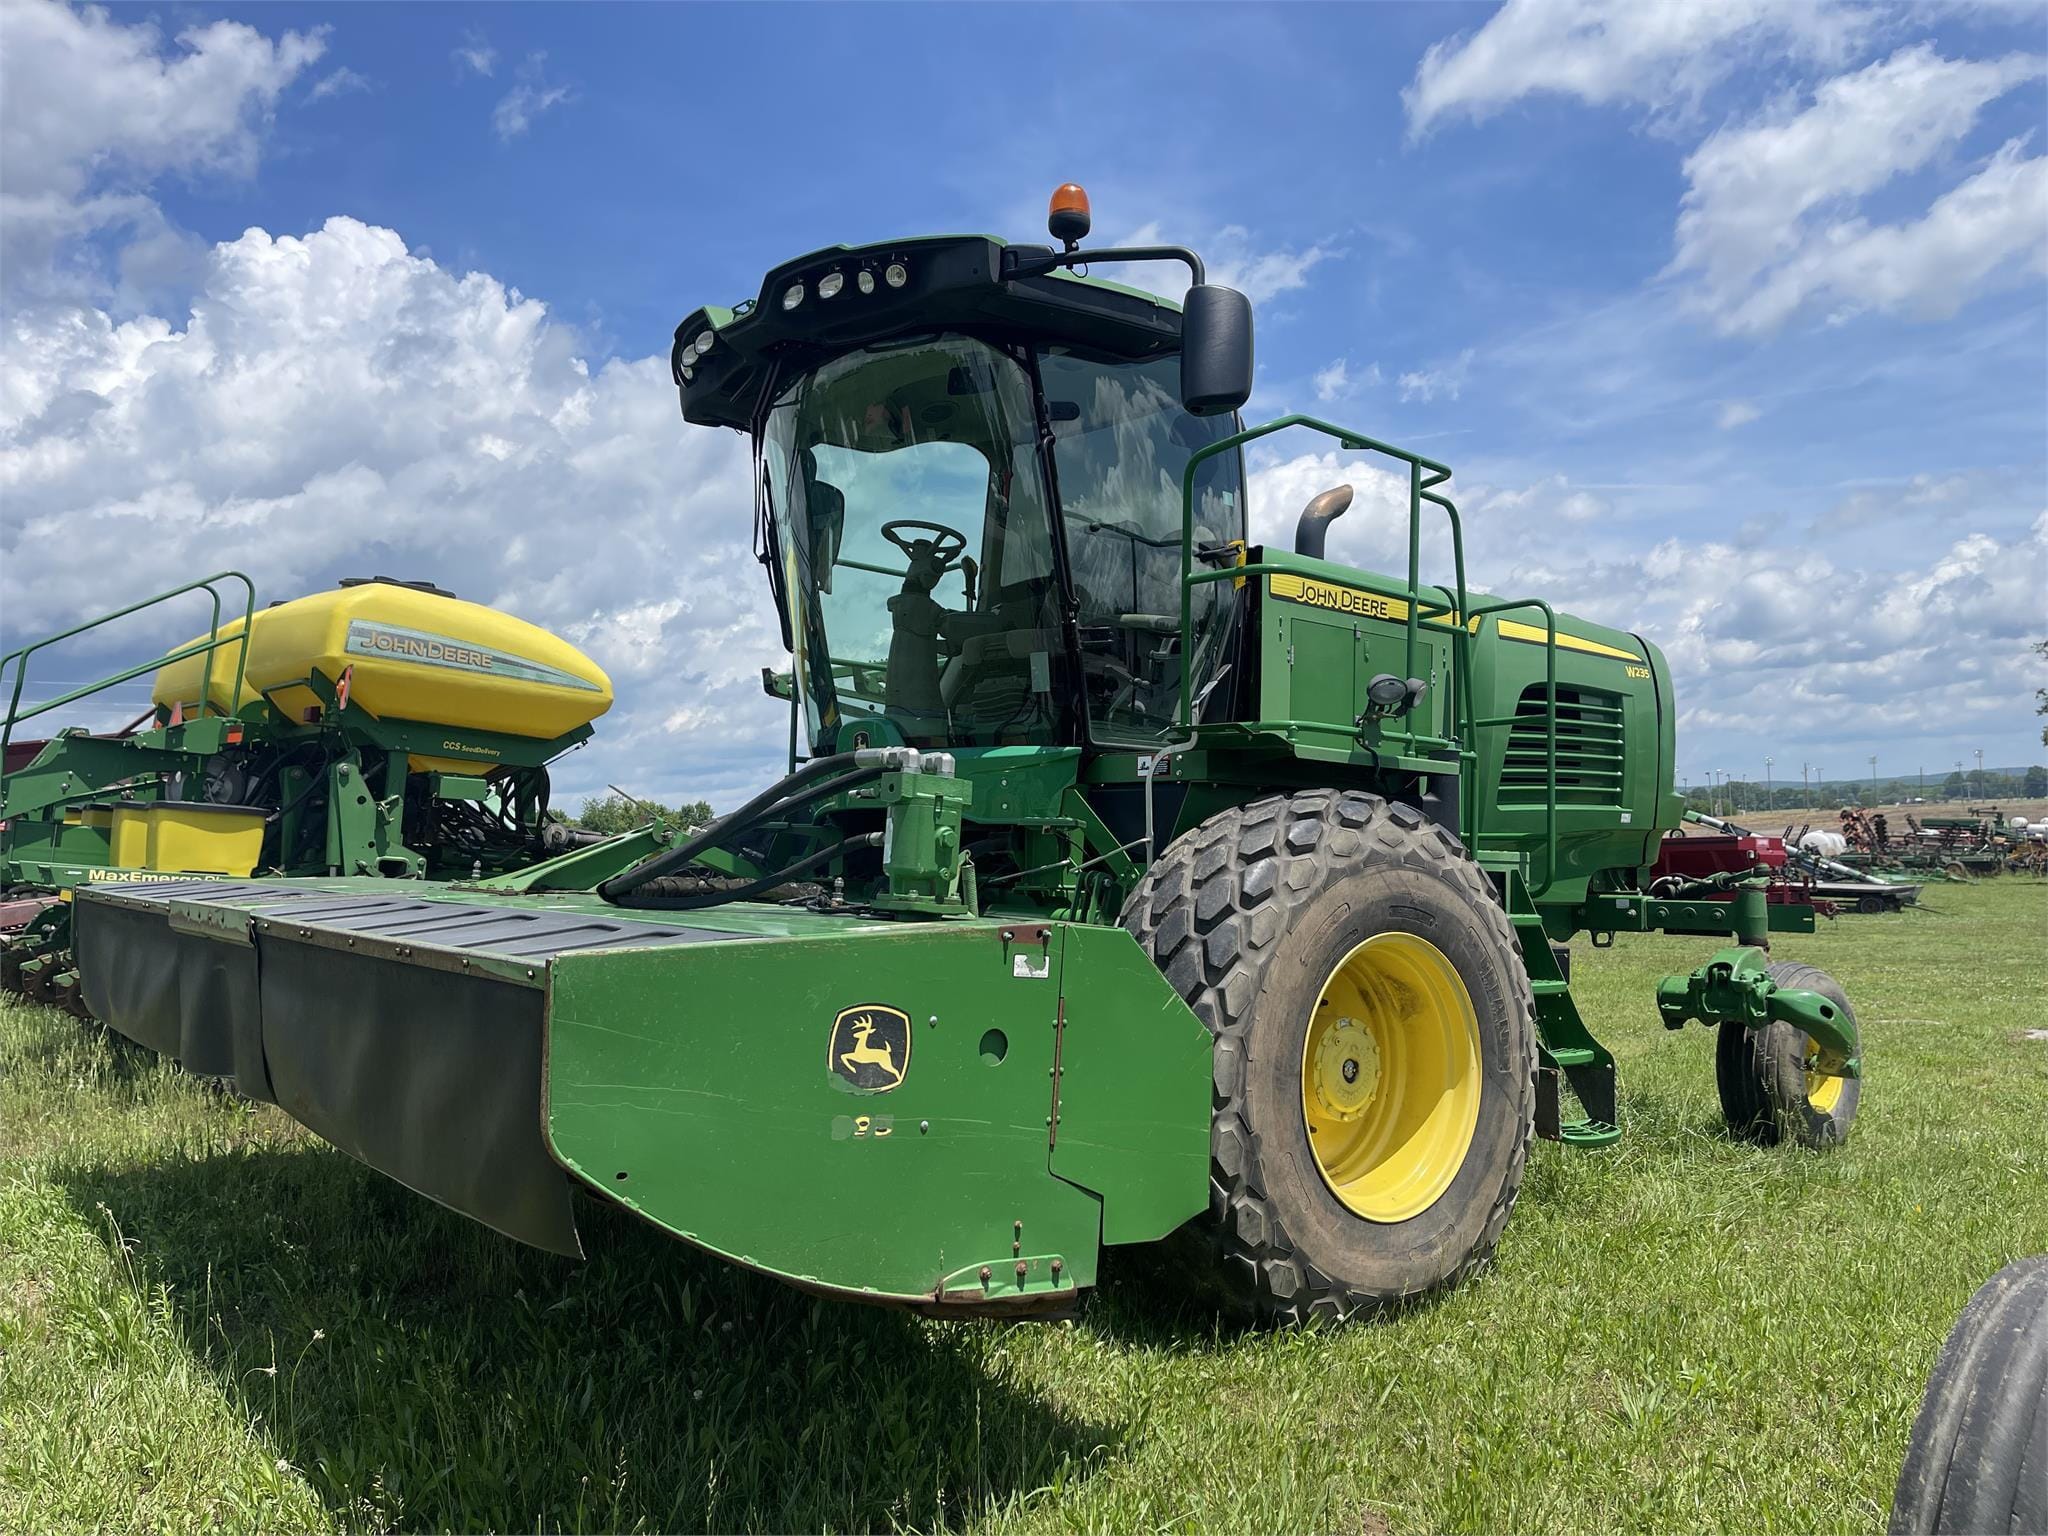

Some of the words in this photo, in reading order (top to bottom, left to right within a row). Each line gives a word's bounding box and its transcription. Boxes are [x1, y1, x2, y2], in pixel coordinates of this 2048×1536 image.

[1296, 581, 1338, 606] JOHN
[1341, 590, 1389, 617] DEERE
[361, 631, 425, 658] JOHN
[427, 640, 493, 668] DEERE
[1624, 665, 1651, 679] W235
[442, 740, 461, 751] CCS
[461, 744, 501, 757] SeedDelivery
